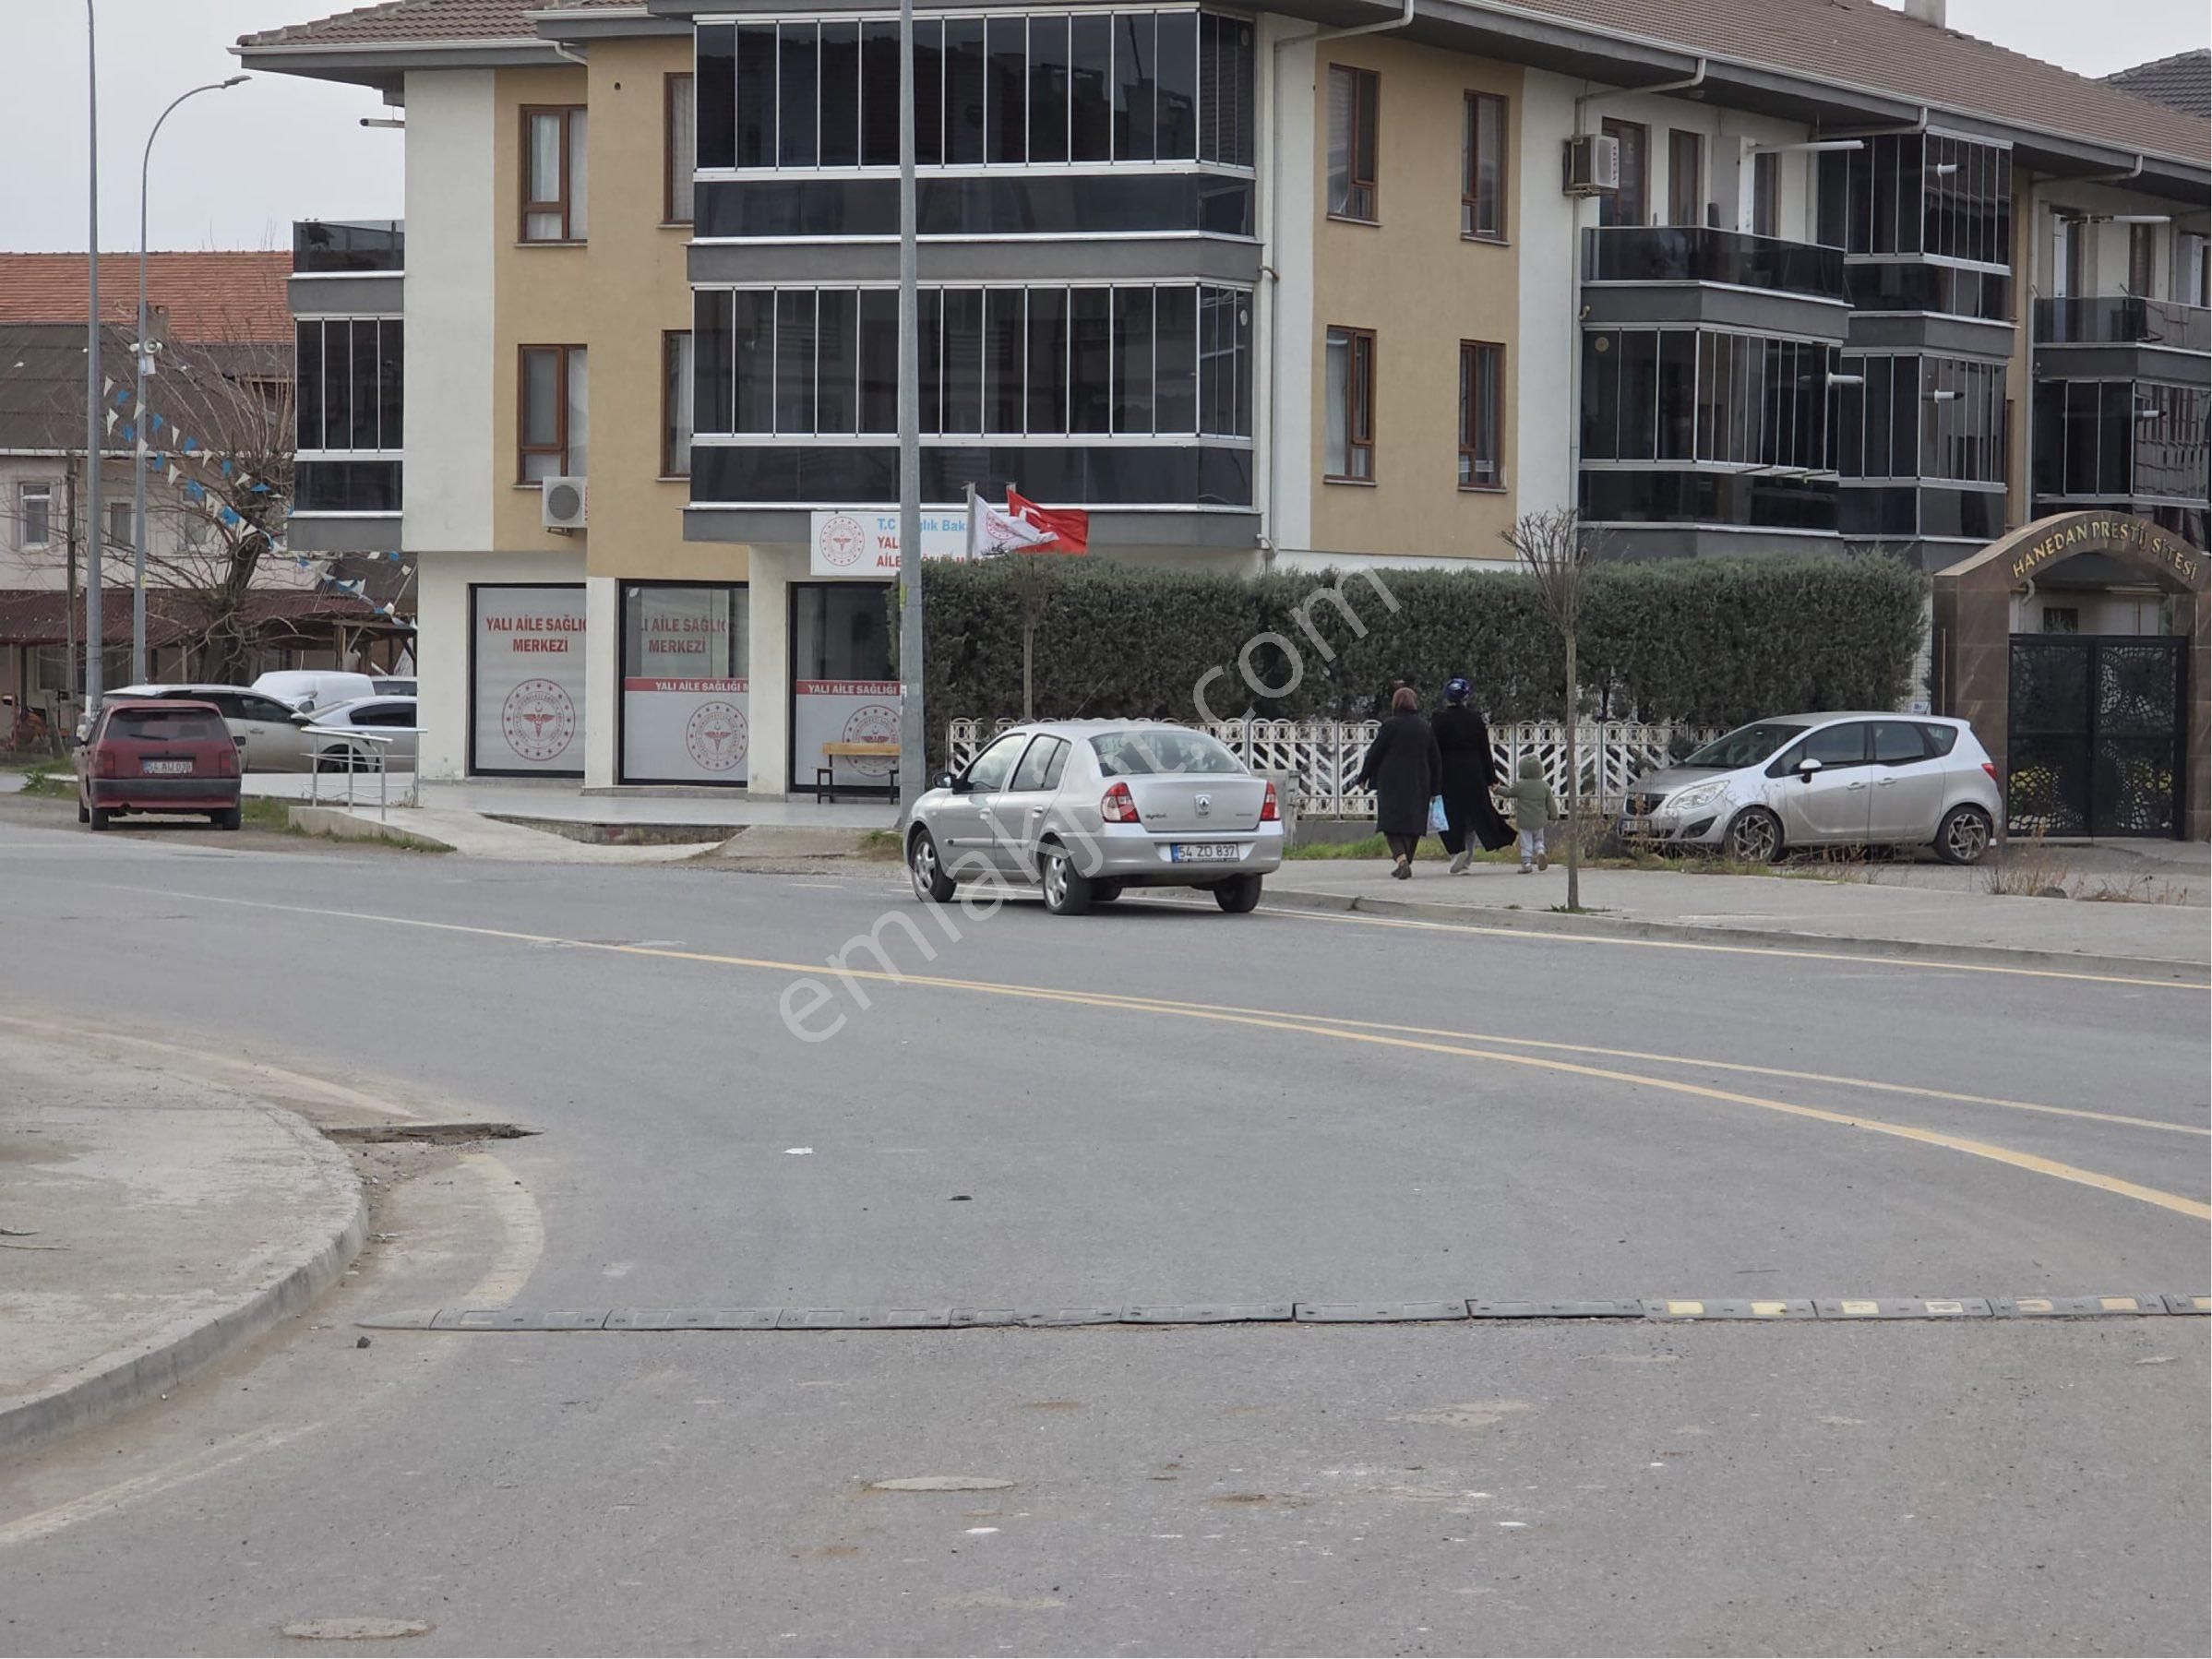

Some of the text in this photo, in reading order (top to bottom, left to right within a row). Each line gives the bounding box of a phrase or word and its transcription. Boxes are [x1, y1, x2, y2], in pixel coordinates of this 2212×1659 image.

[942, 519, 967, 531] Bak
[878, 536, 901, 549] YAL
[2012, 522, 2088, 579] HANEDAN
[486, 616, 512, 631] YALI
[516, 614, 543, 631] AİLE
[652, 613, 680, 632] AİLE
[512, 636, 568, 653] MERKEZİ
[649, 636, 706, 653] MERKEZİ
[656, 681, 676, 691] YALI
[679, 680, 700, 691] AİLE
[702, 680, 741, 692] SAĞLIĞI
[808, 683, 897, 695] YALI AİLE SAĞLIĞI
[1178, 845, 1192, 857] 54
[1216, 845, 1235, 857] 837
